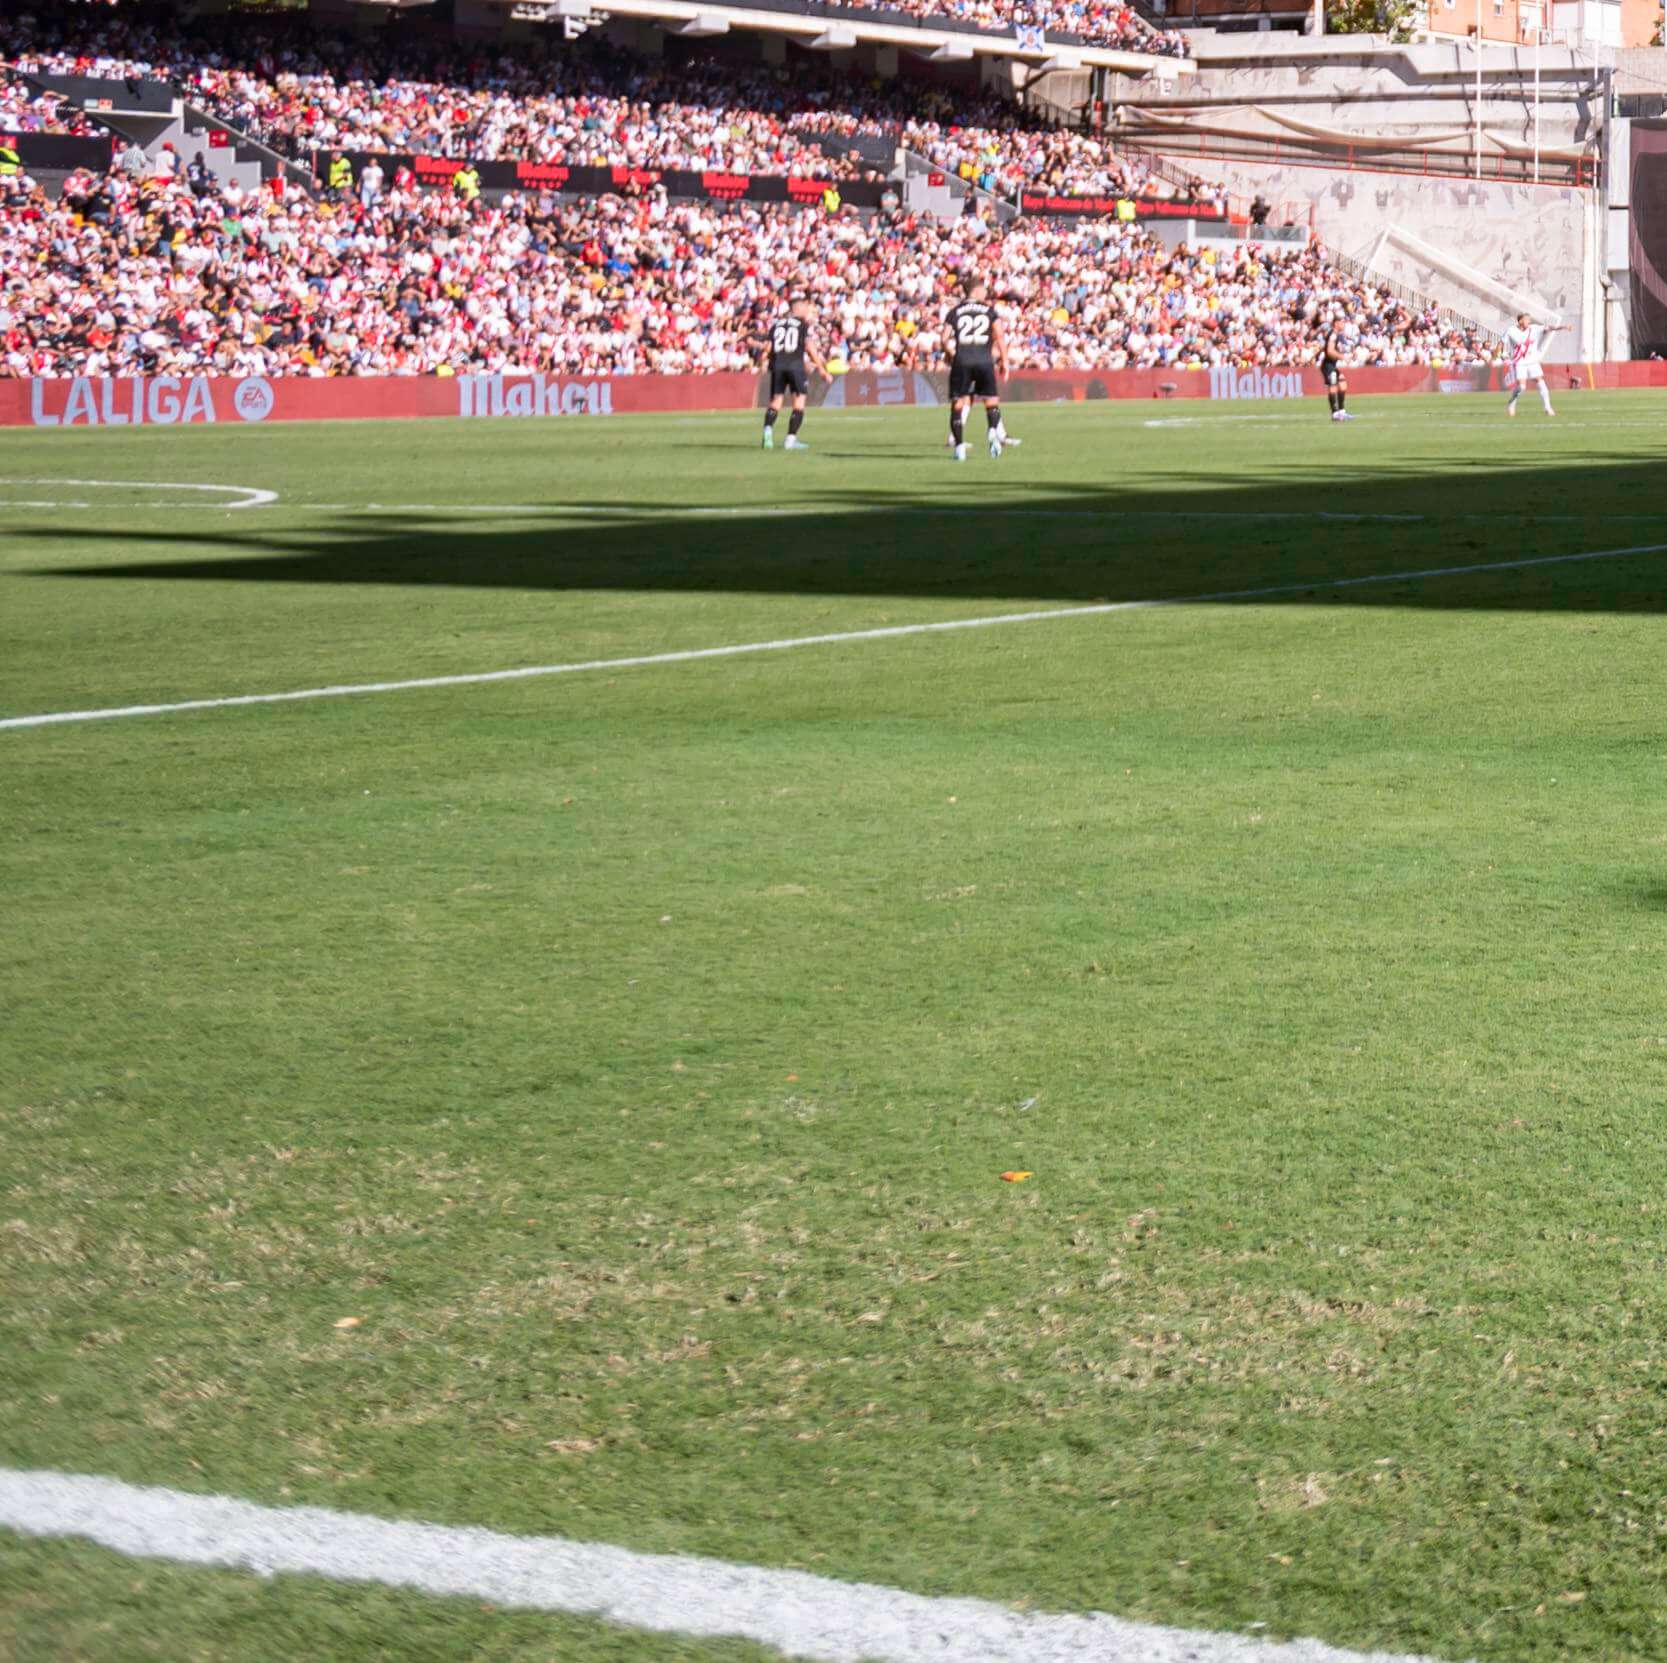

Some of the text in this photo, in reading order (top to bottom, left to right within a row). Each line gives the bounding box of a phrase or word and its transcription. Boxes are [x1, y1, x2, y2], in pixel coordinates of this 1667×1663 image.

[774, 327, 798, 352] 20
[957, 315, 990, 344] 22
[458, 371, 613, 416] Mahou
[1209, 367, 1303, 400] Mahou
[32, 377, 216, 424] LALIGA
